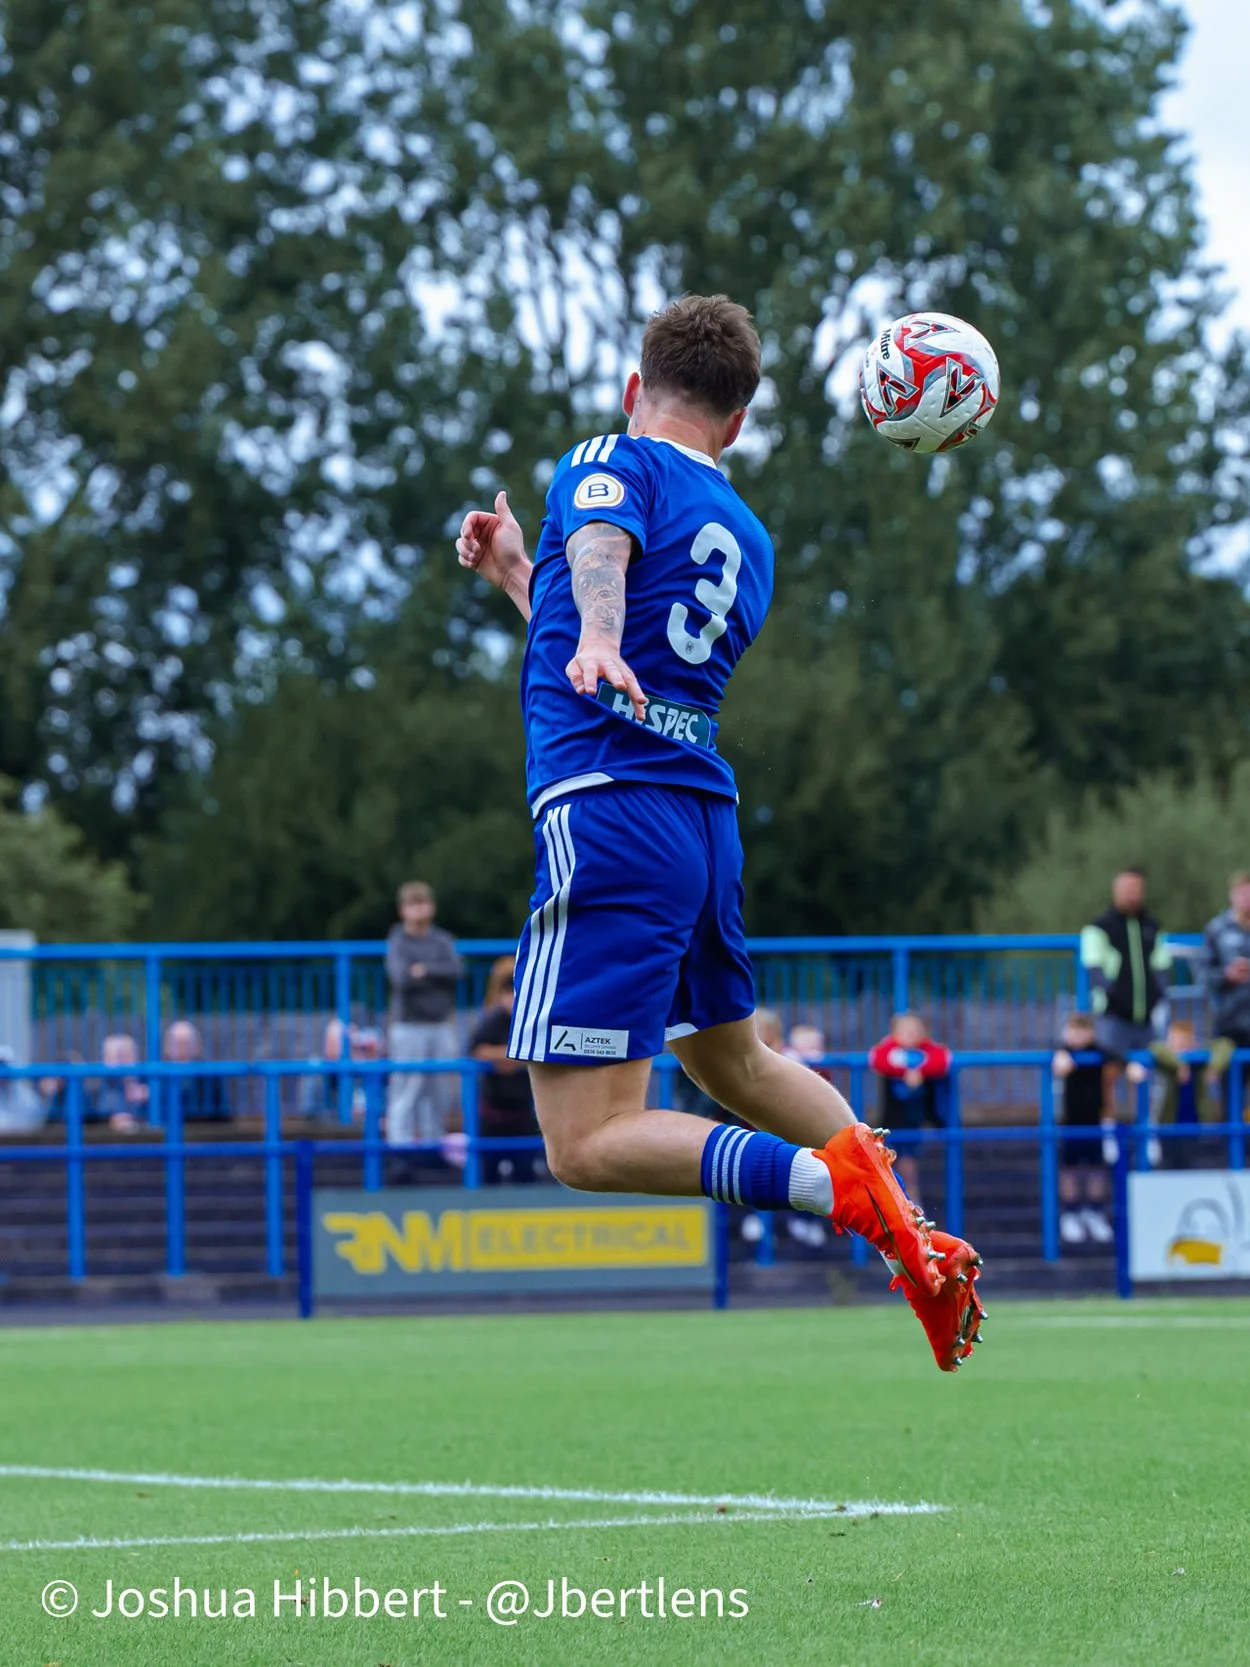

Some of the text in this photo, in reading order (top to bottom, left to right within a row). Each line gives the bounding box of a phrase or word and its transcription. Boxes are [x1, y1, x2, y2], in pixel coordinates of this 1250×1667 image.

[880, 328, 891, 360] Mitre
[587, 483, 609, 498] B
[667, 522, 741, 665] 3
[585, 1036, 611, 1044] AZTEK
[478, 1219, 692, 1255] ELECTRICAL
